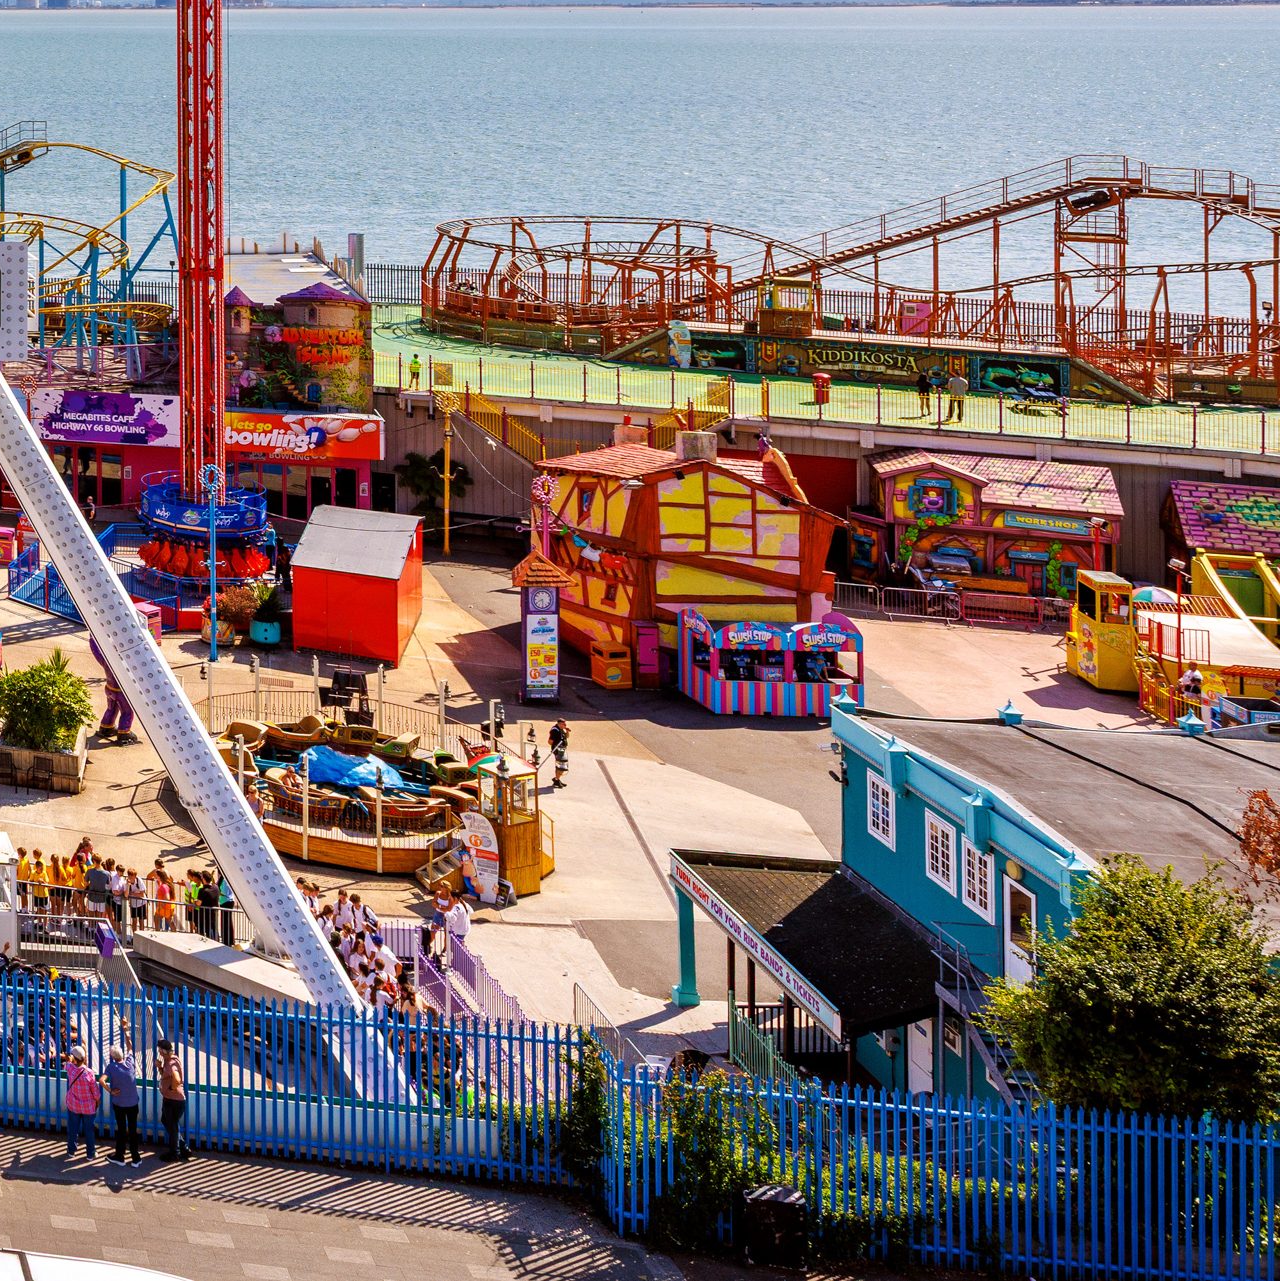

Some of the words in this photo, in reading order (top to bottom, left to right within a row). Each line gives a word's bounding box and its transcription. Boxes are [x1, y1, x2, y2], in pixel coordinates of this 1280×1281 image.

[282, 327, 366, 346] ADVENTURE
[63, 412, 111, 423] MEGABITES
[52, 421, 92, 433] HIGHWAY
[93, 423, 104, 433] 66
[105, 424, 146, 435] BOWLING
[232, 421, 256, 430] lets
[256, 422, 273, 432] go
[224, 427, 319, 453] bowling!
[1015, 516, 1079, 530] WORKSHOP
[728, 631, 752, 645] SLUSH
[752, 629, 772, 643] STOP
[802, 633, 826, 648] SLUSH
[826, 632, 847, 645] STOP
[675, 866, 691, 888] TURN
[692, 882, 710, 906] RIGHT
[711, 899, 723, 919] FOR
[724, 914, 742, 938] YOUR
[743, 932, 759, 954] RIDE
[760, 947, 784, 977] BANDS
[785, 972, 792, 985] &
[792, 978, 820, 1013] TICKETS
